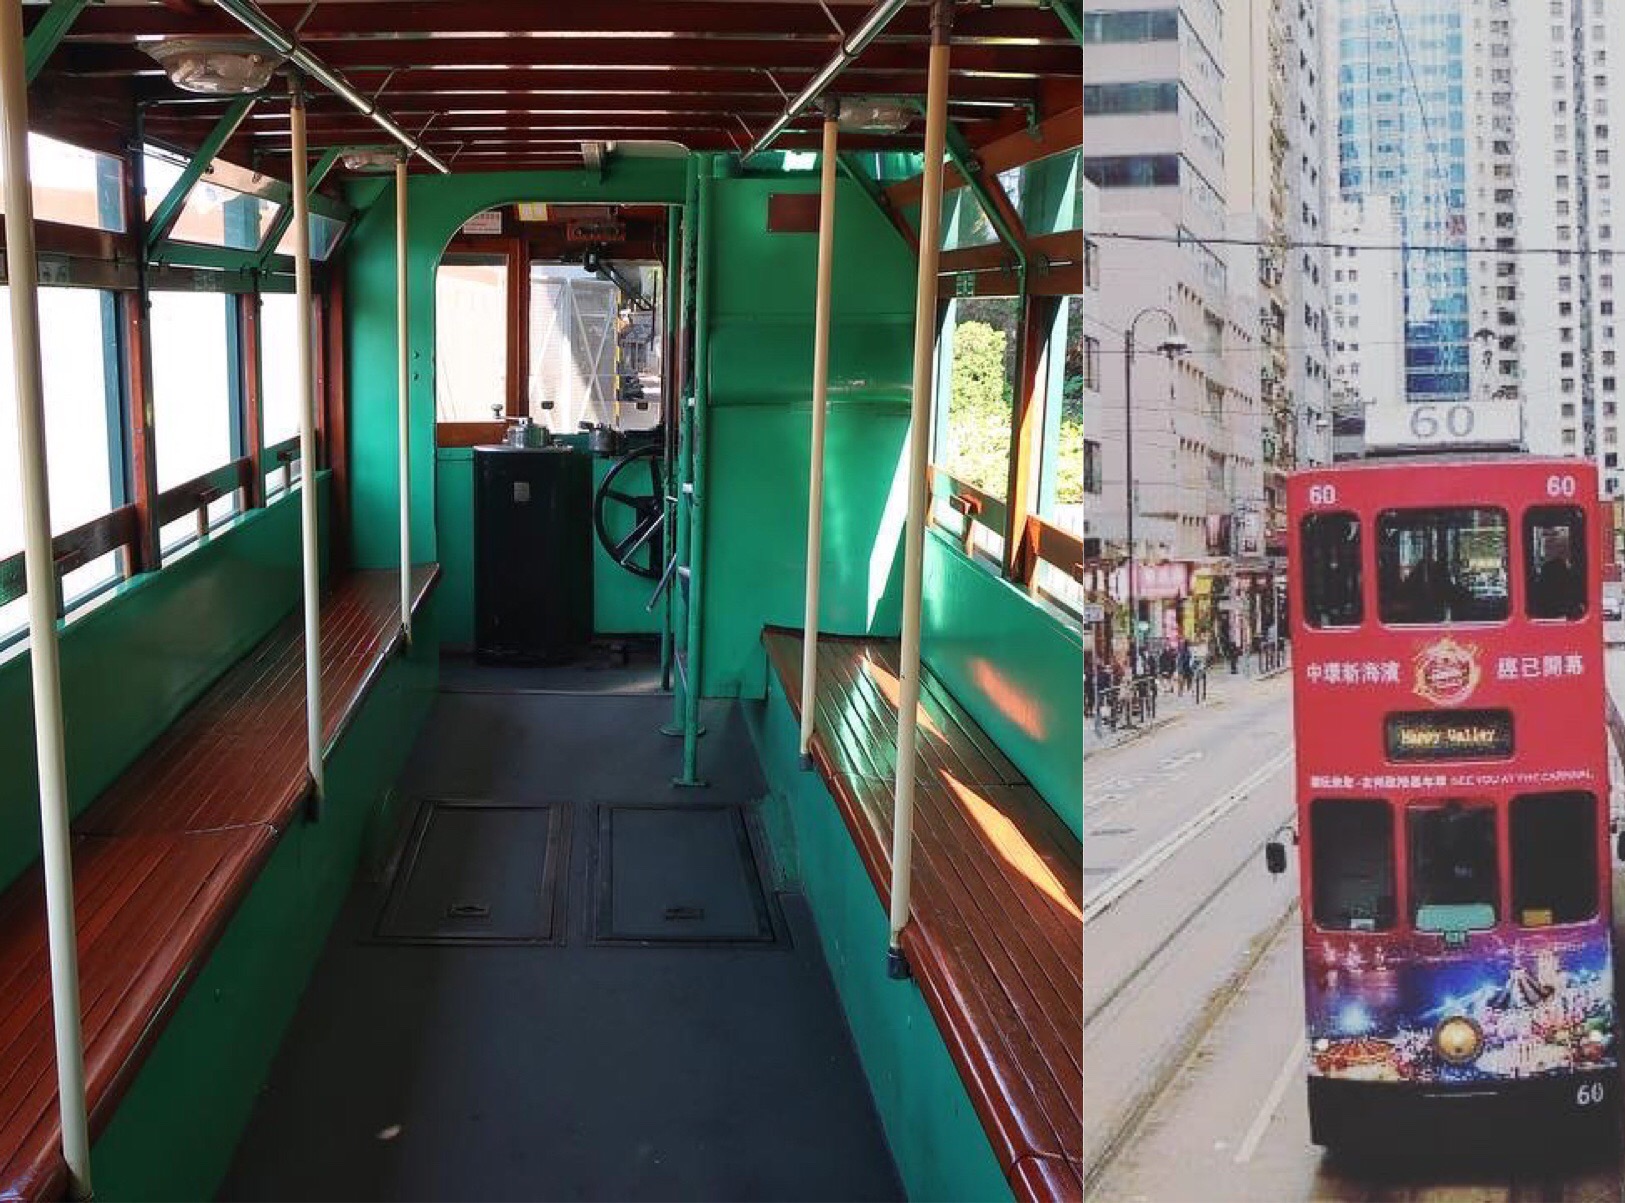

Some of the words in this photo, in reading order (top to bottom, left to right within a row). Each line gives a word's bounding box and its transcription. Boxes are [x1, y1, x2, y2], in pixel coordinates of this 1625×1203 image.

[1411, 405, 1474, 437] 60
[1309, 485, 1336, 504] 60
[1547, 476, 1576, 496] 60
[1576, 1083, 1604, 1105] 60
